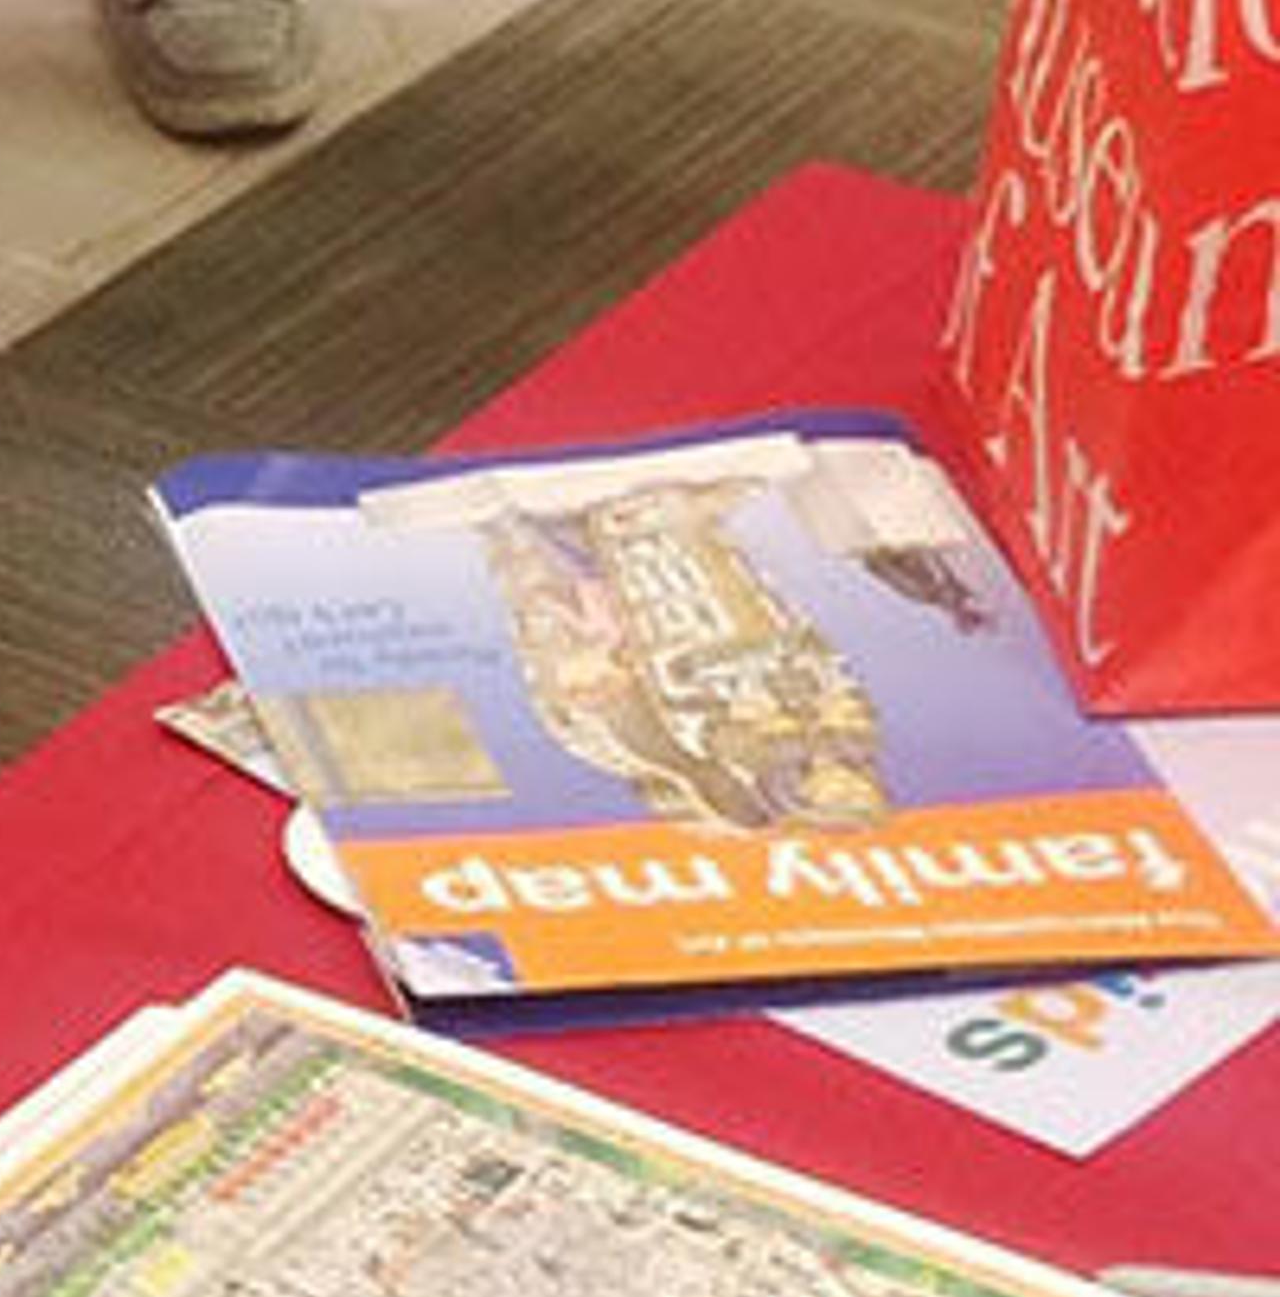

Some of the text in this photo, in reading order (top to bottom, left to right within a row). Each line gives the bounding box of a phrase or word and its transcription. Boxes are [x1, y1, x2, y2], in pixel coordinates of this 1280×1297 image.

[983, 269, 1130, 666] Art
[419, 853, 734, 911] map
[766, 827, 1188, 906] family
